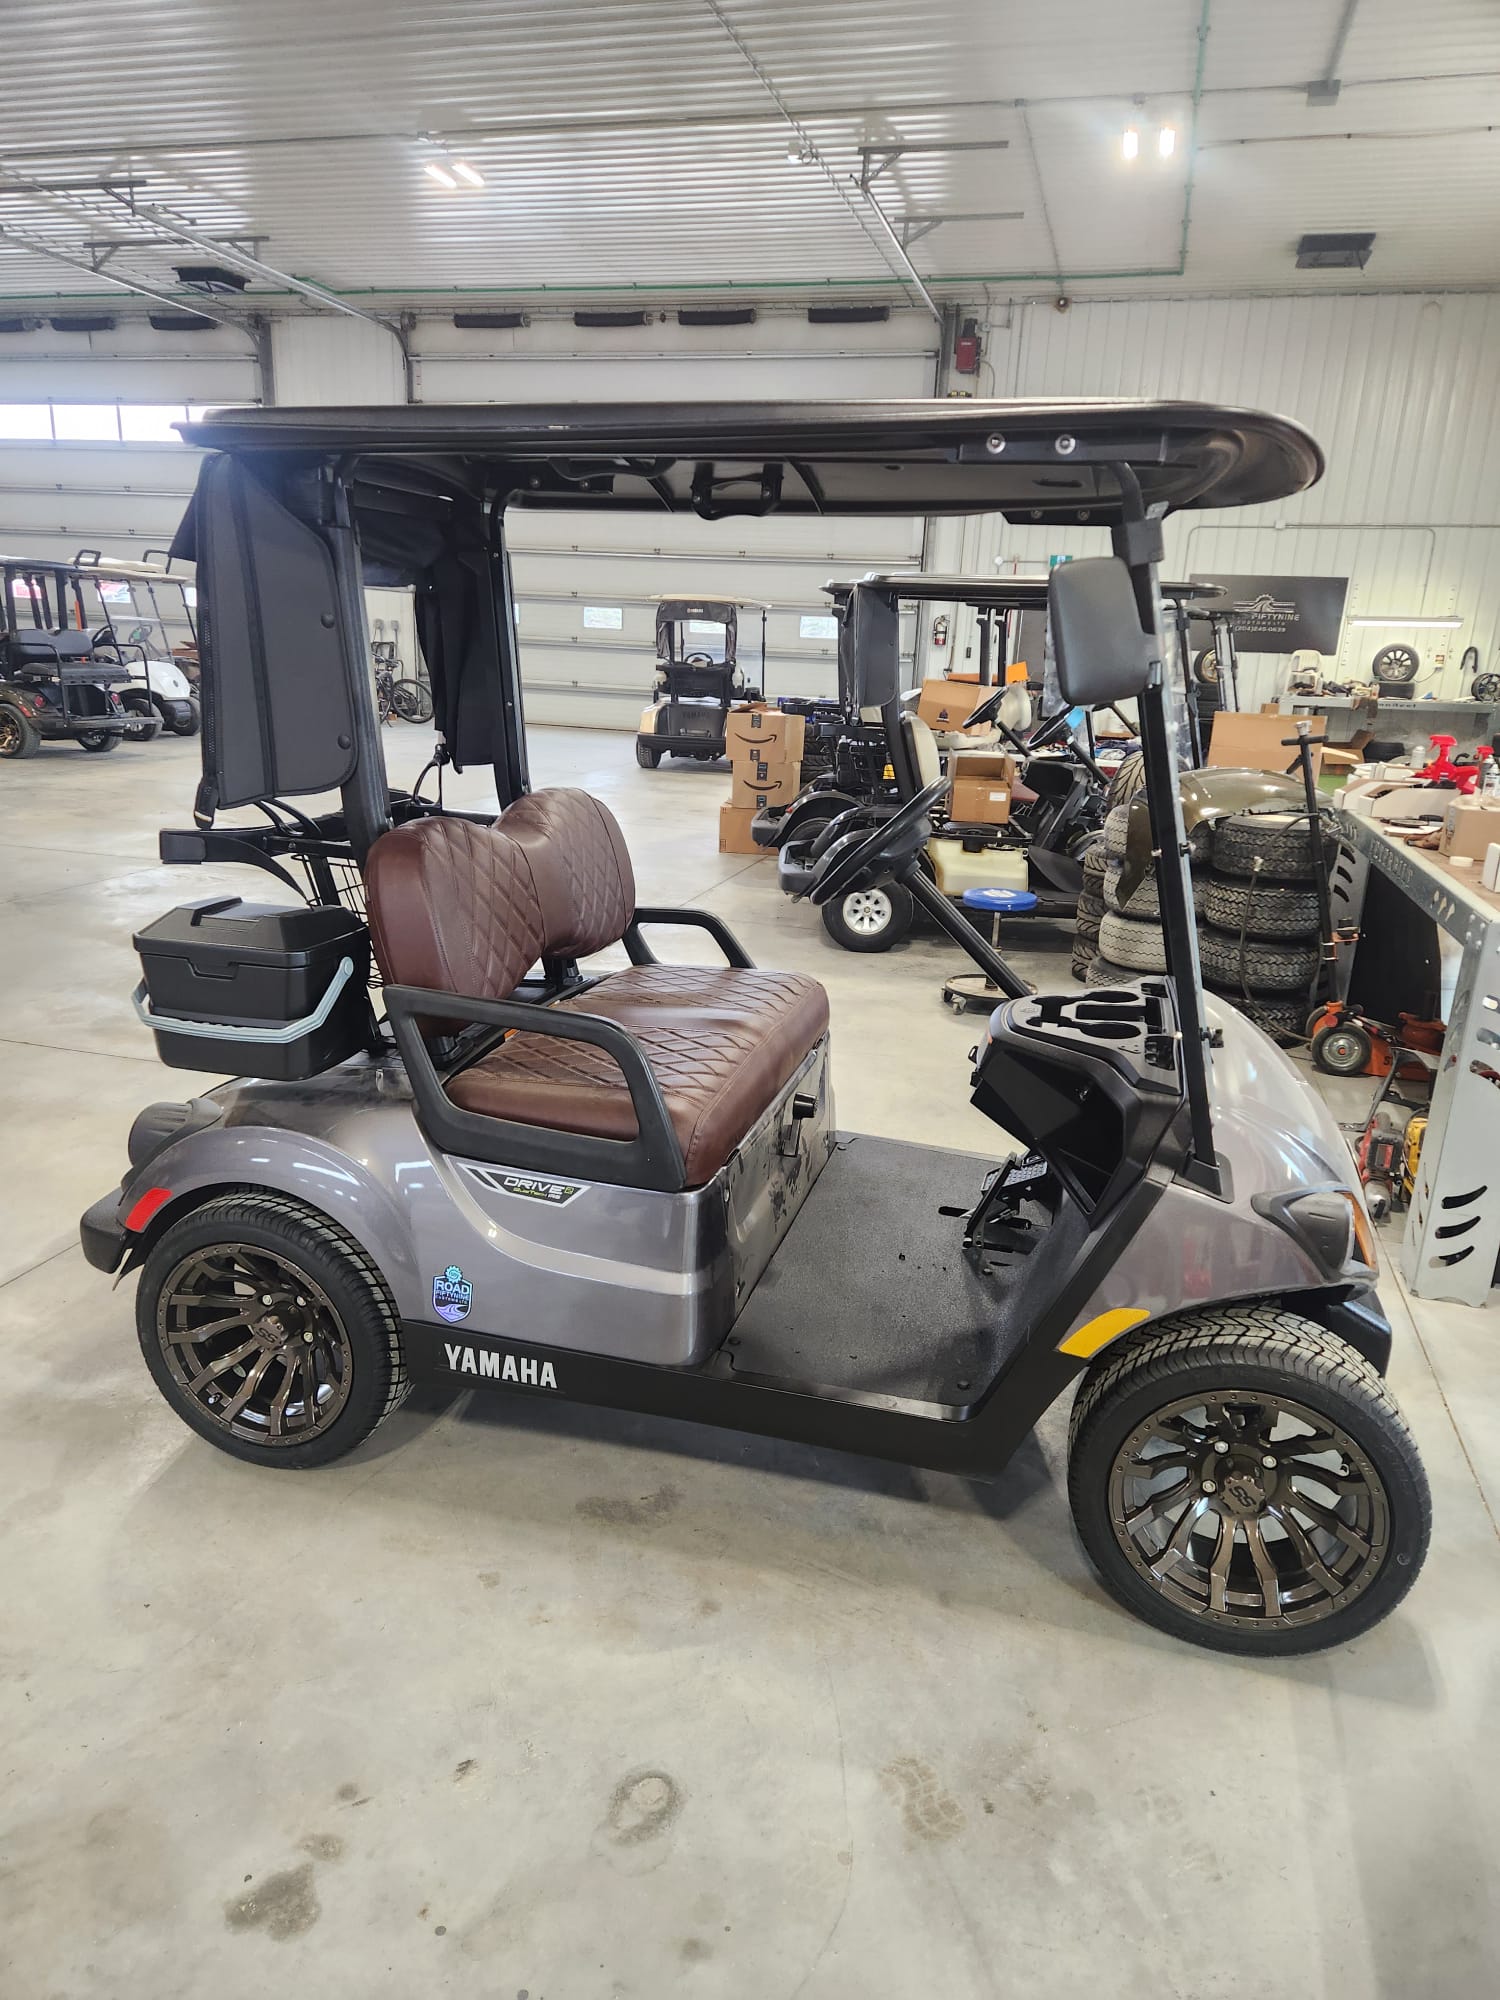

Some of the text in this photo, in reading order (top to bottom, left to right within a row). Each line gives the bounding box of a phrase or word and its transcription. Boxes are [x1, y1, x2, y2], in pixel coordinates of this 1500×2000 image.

[436, 1280, 470, 1295] ROAD
[435, 1290, 470, 1301] FIFTYNINE
[444, 1343, 558, 1389] YAMAHA
